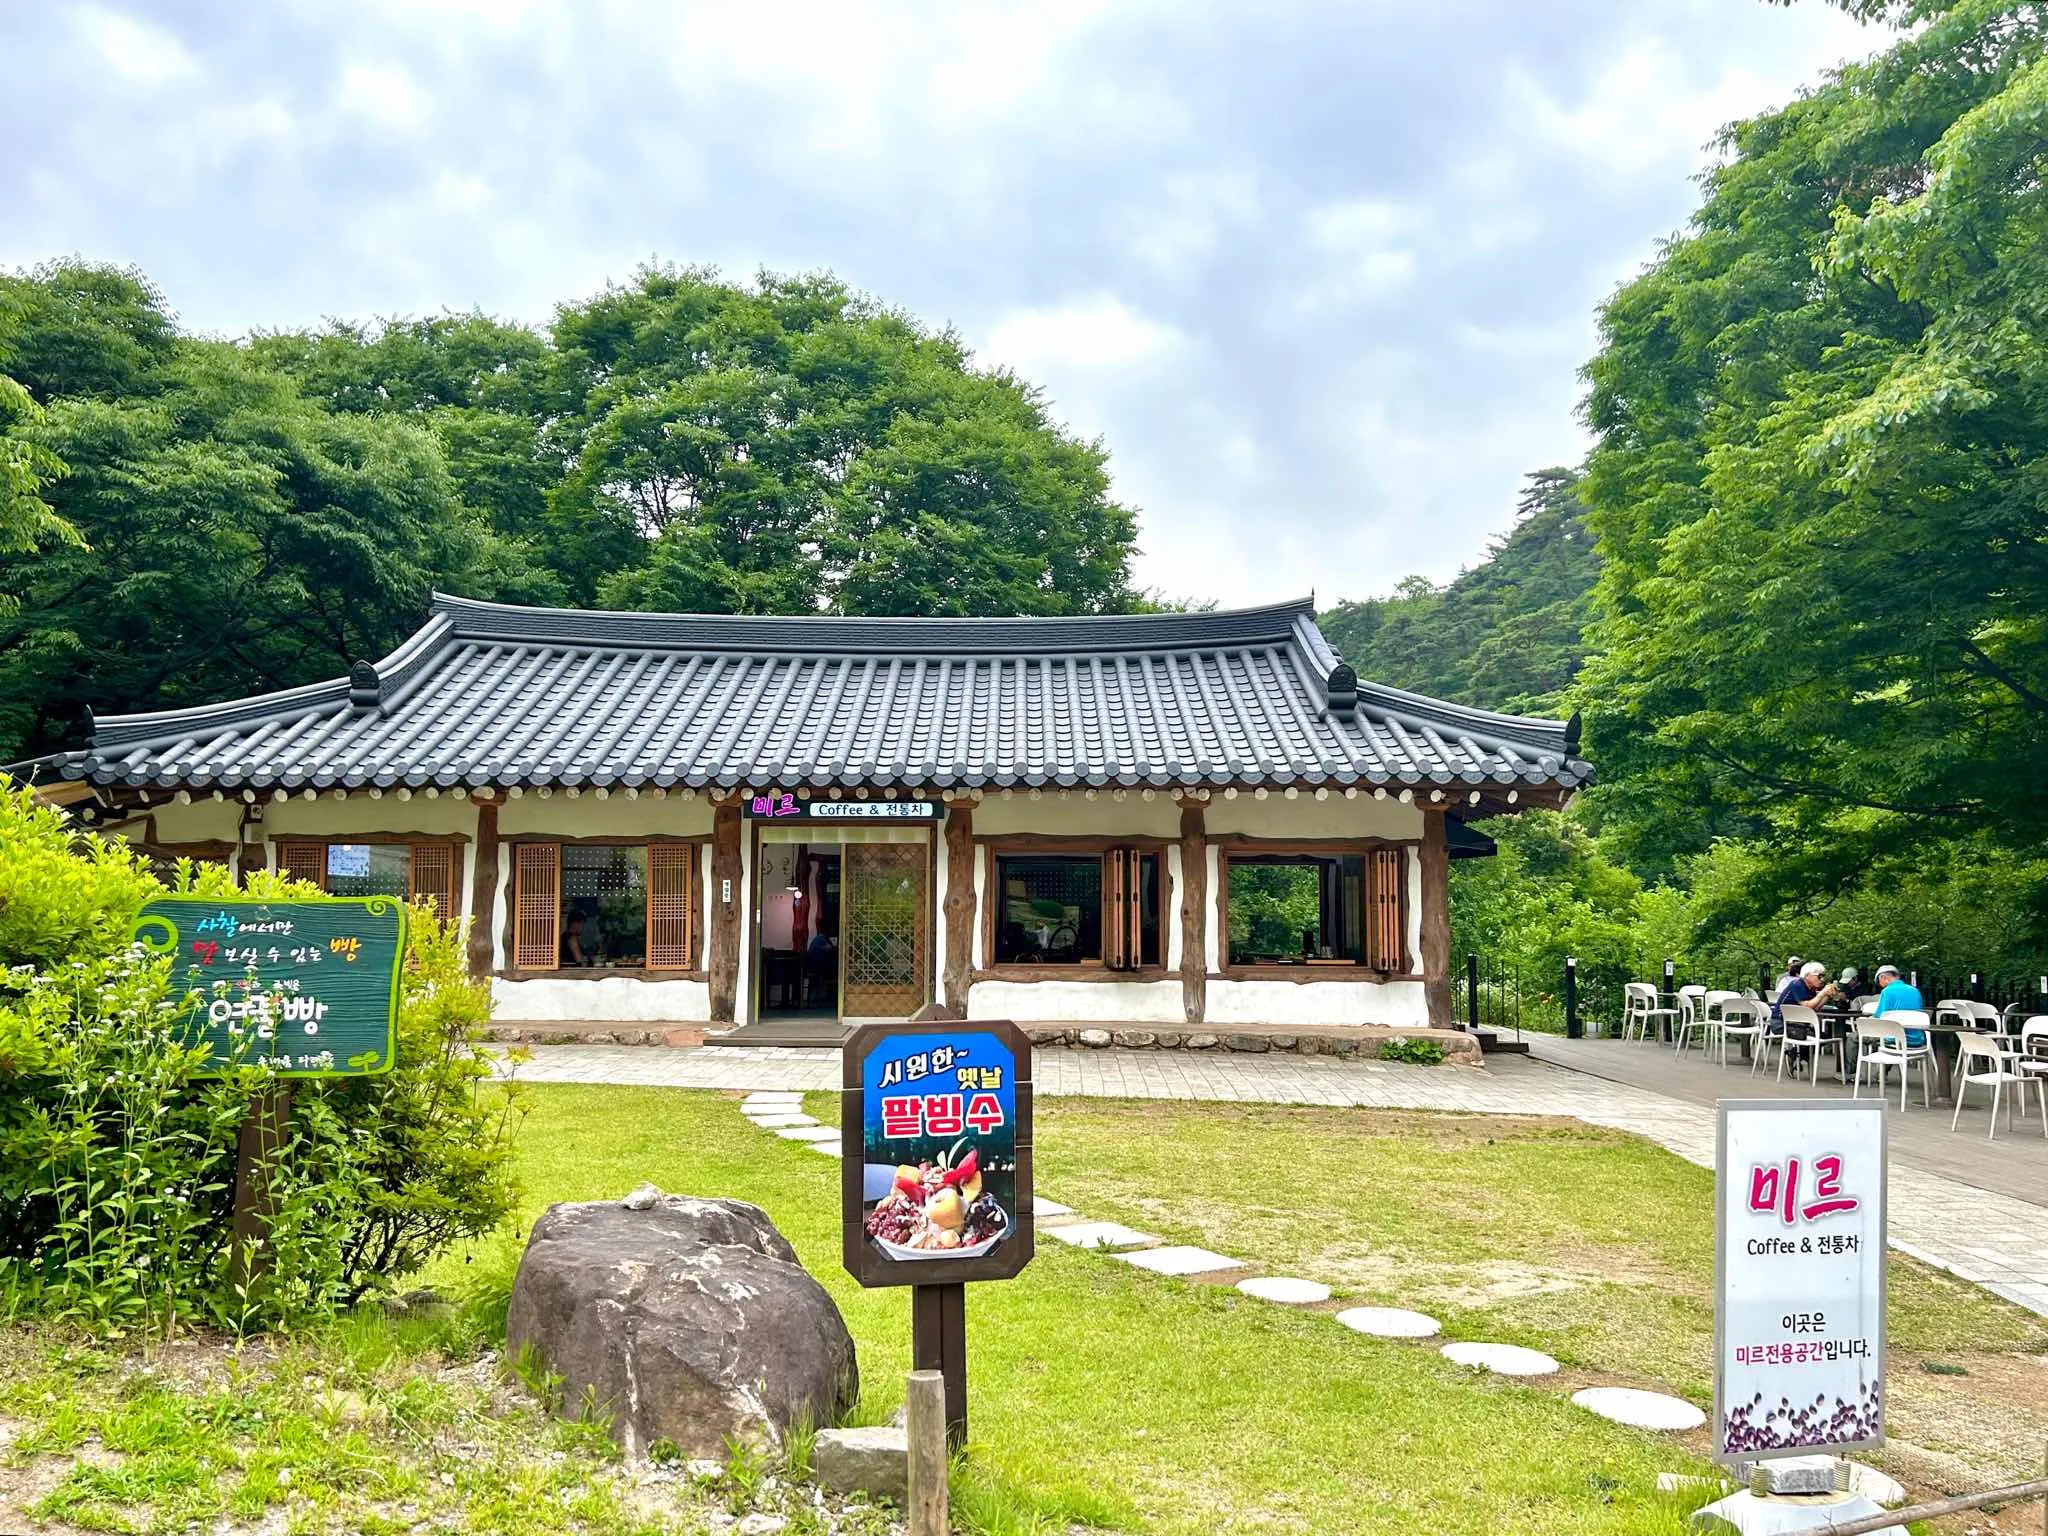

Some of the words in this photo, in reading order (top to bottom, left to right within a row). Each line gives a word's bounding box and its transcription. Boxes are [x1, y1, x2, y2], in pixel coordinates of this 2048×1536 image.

[752, 793, 801, 817] 미르
[818, 804, 863, 816] Coffee
[869, 804, 880, 816] &
[886, 803, 924, 816] 전통차
[196, 911, 294, 938] 사찰에서만
[225, 947, 258, 965] 보실
[266, 946, 281, 963] 수
[290, 947, 323, 963] 있는
[329, 936, 362, 962] 빵
[957, 1066, 1002, 1090] 옛날
[882, 1093, 1004, 1138] 팥빙수
[1748, 1156, 1858, 1223] 미르
[1747, 1237, 1796, 1255] Coffee
[1800, 1237, 1813, 1253] &
[1817, 1234, 1860, 1254] 전통차
[1782, 1312, 1826, 1334] 이곳은
[1736, 1338, 1872, 1366] 미르전용공간입니다.
